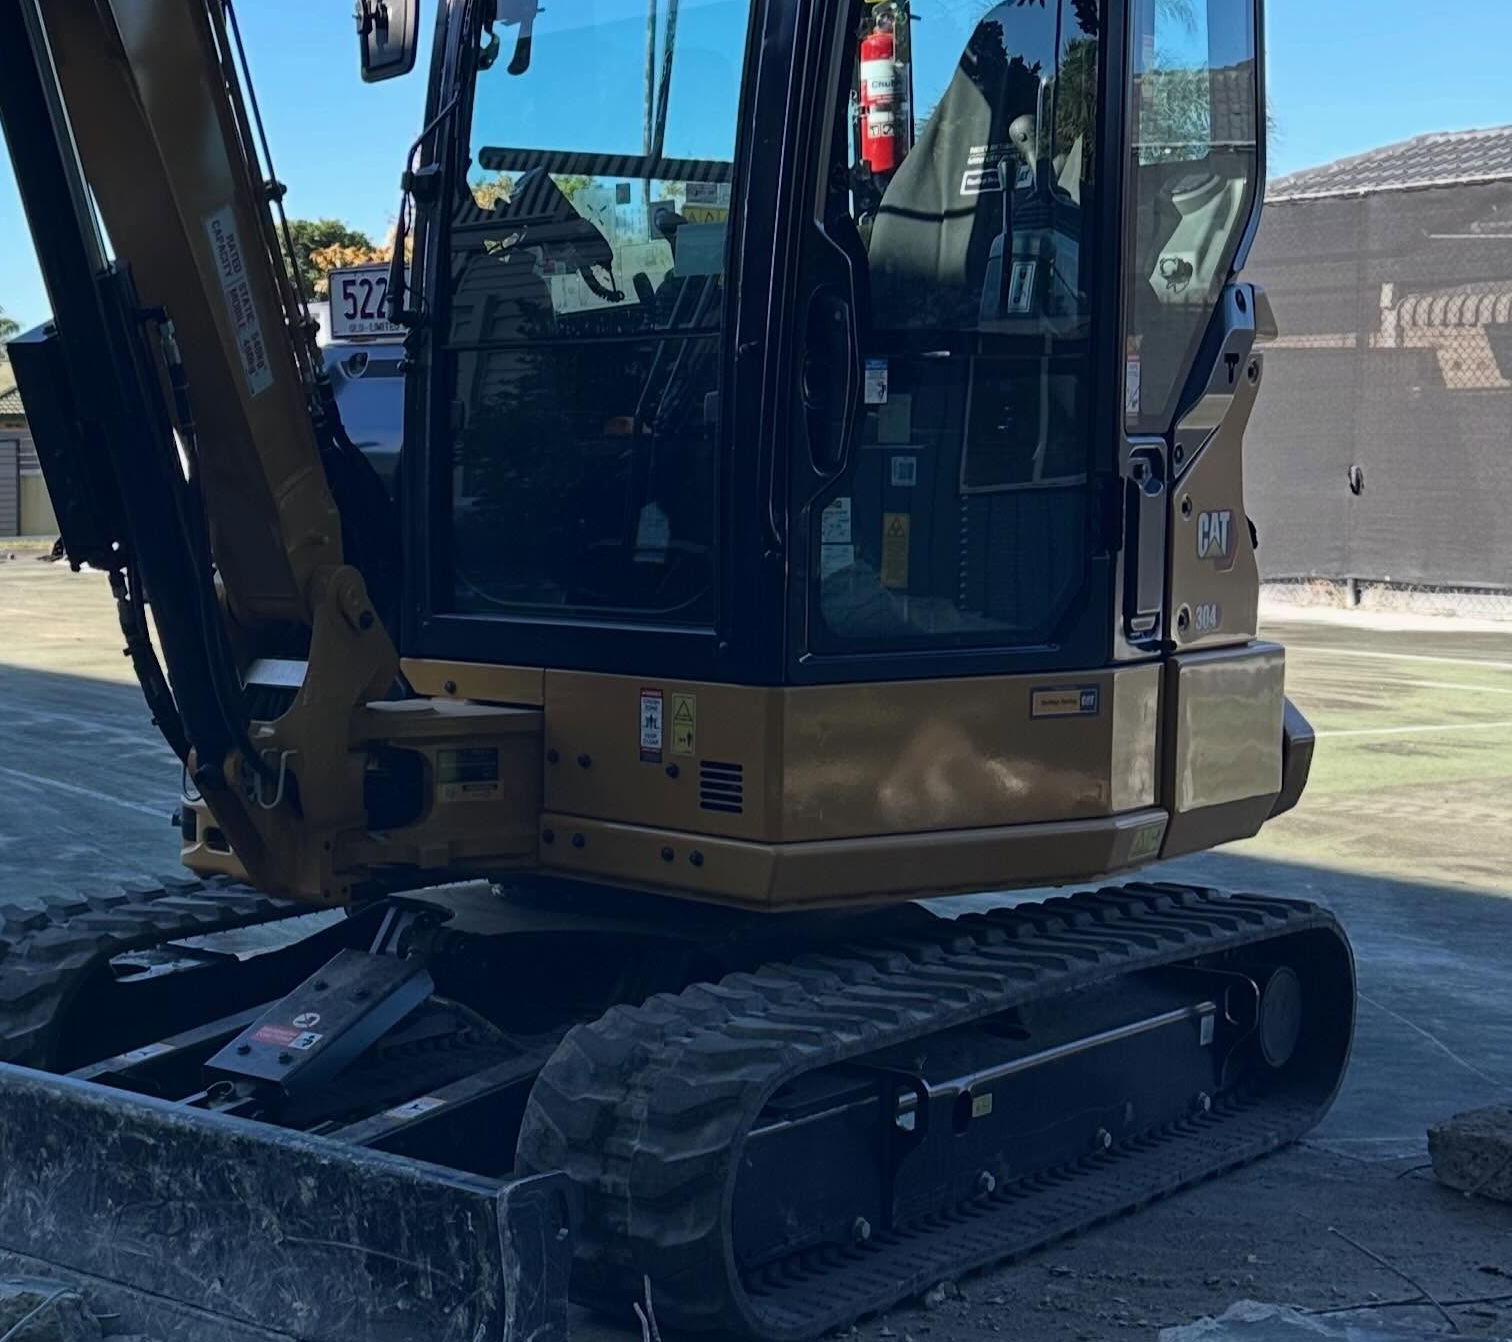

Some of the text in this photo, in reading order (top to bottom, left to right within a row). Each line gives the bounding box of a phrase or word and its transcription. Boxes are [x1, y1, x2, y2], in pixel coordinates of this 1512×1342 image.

[212, 220, 233, 277] CAPACITY
[227, 233, 242, 273] RATED
[238, 281, 256, 323] STATIC
[1197, 512, 1231, 558] CAT
[1195, 604, 1217, 632] 304
